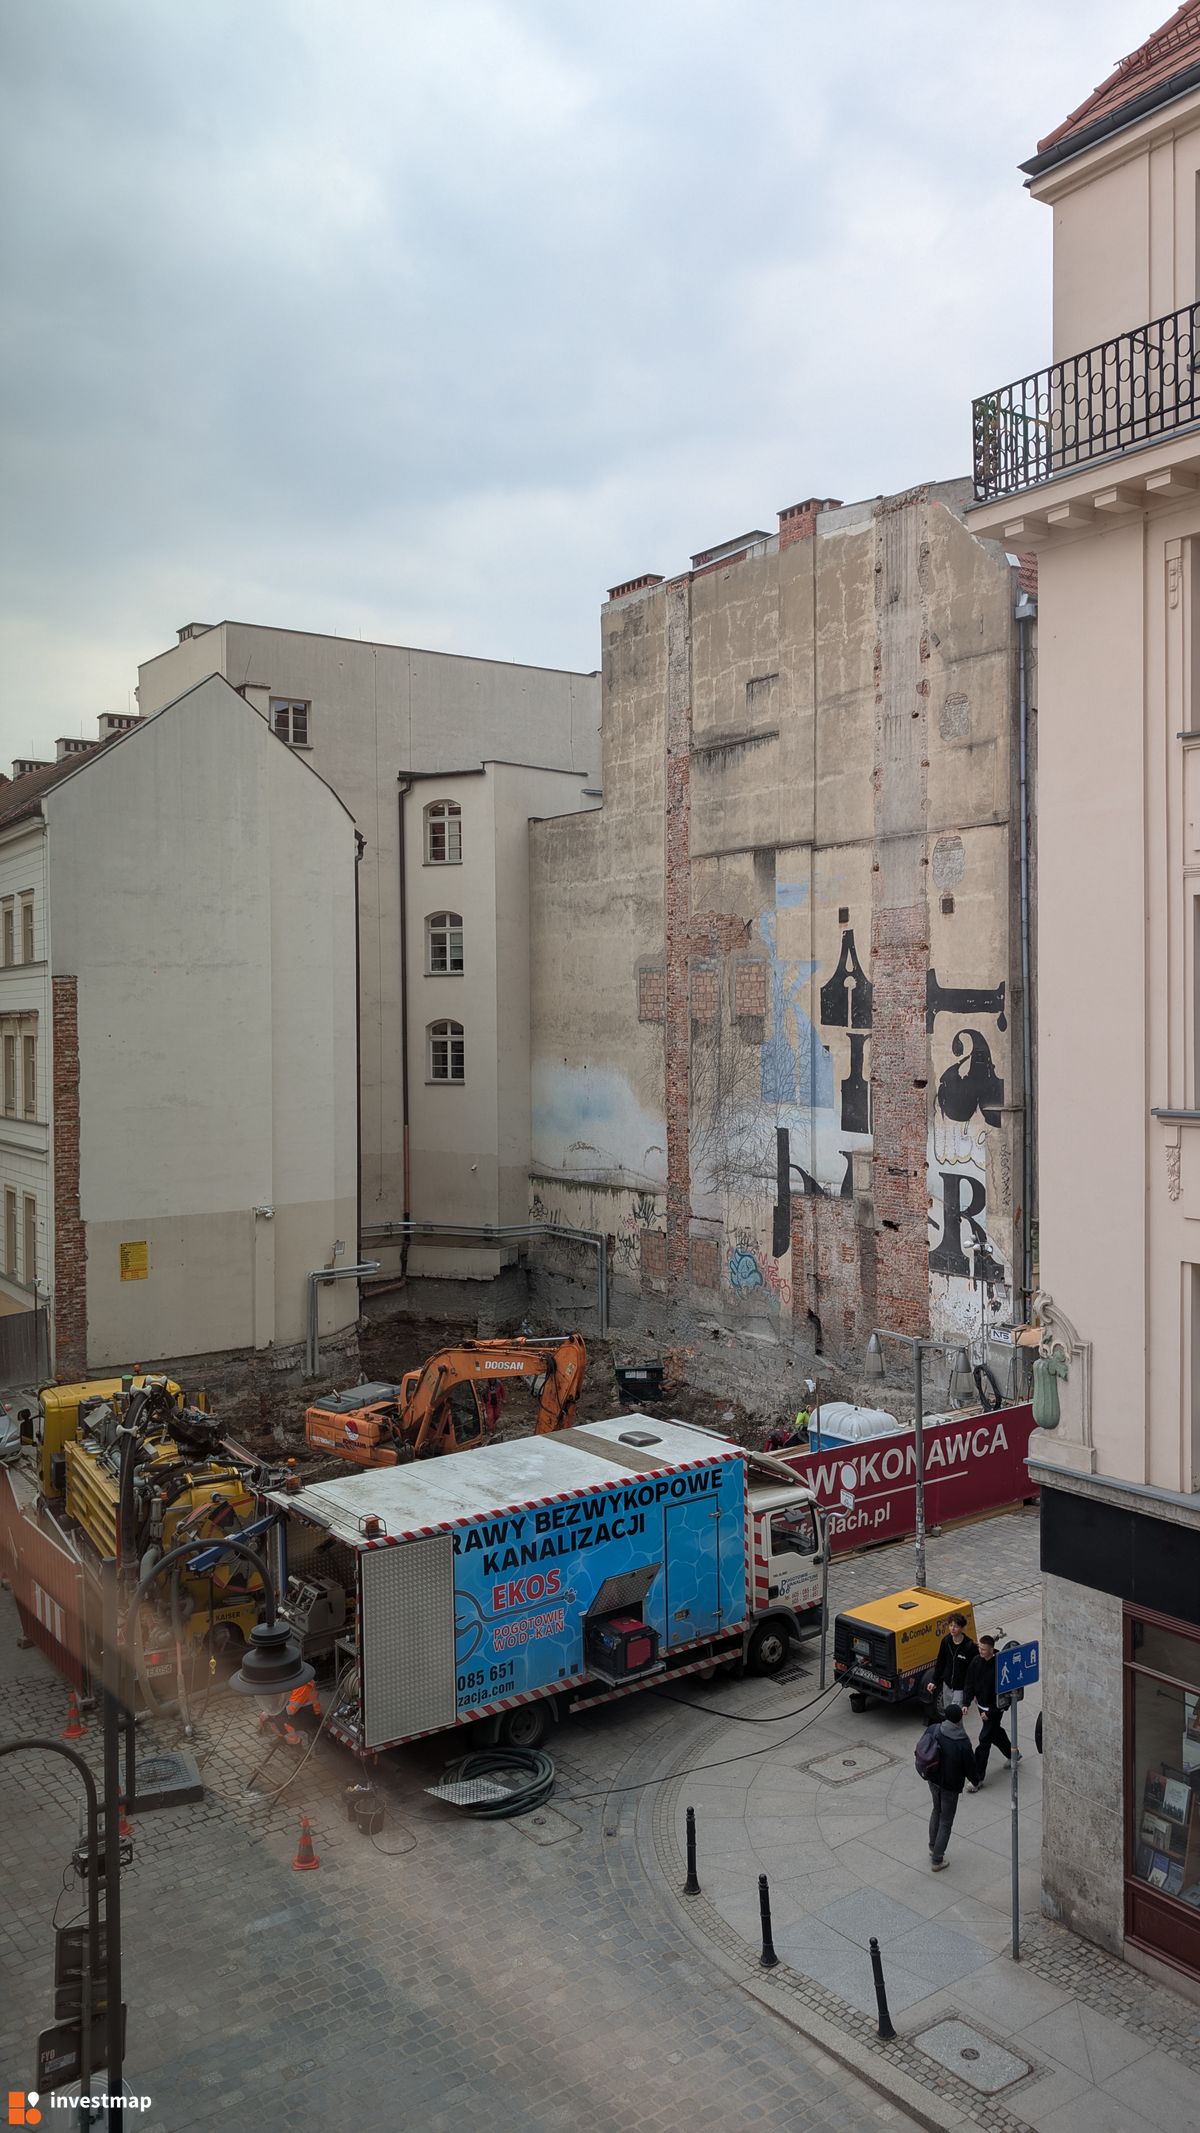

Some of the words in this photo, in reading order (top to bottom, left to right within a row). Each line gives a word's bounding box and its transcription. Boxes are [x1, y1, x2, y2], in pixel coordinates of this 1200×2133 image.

[484, 1360, 524, 1371] DOOSAN
[535, 1468, 722, 1534] BEZWYKOPOWE
[483, 1512, 645, 1576] KANALIZACJI
[492, 1568, 561, 1612] EKOS
[215, 1611, 241, 1621] KAISER
[493, 1608, 565, 1640] POGOTOWIE
[493, 1620, 565, 1653] WOD-KAN
[457, 1669, 484, 1691] 085
[489, 1660, 514, 1681] 651
